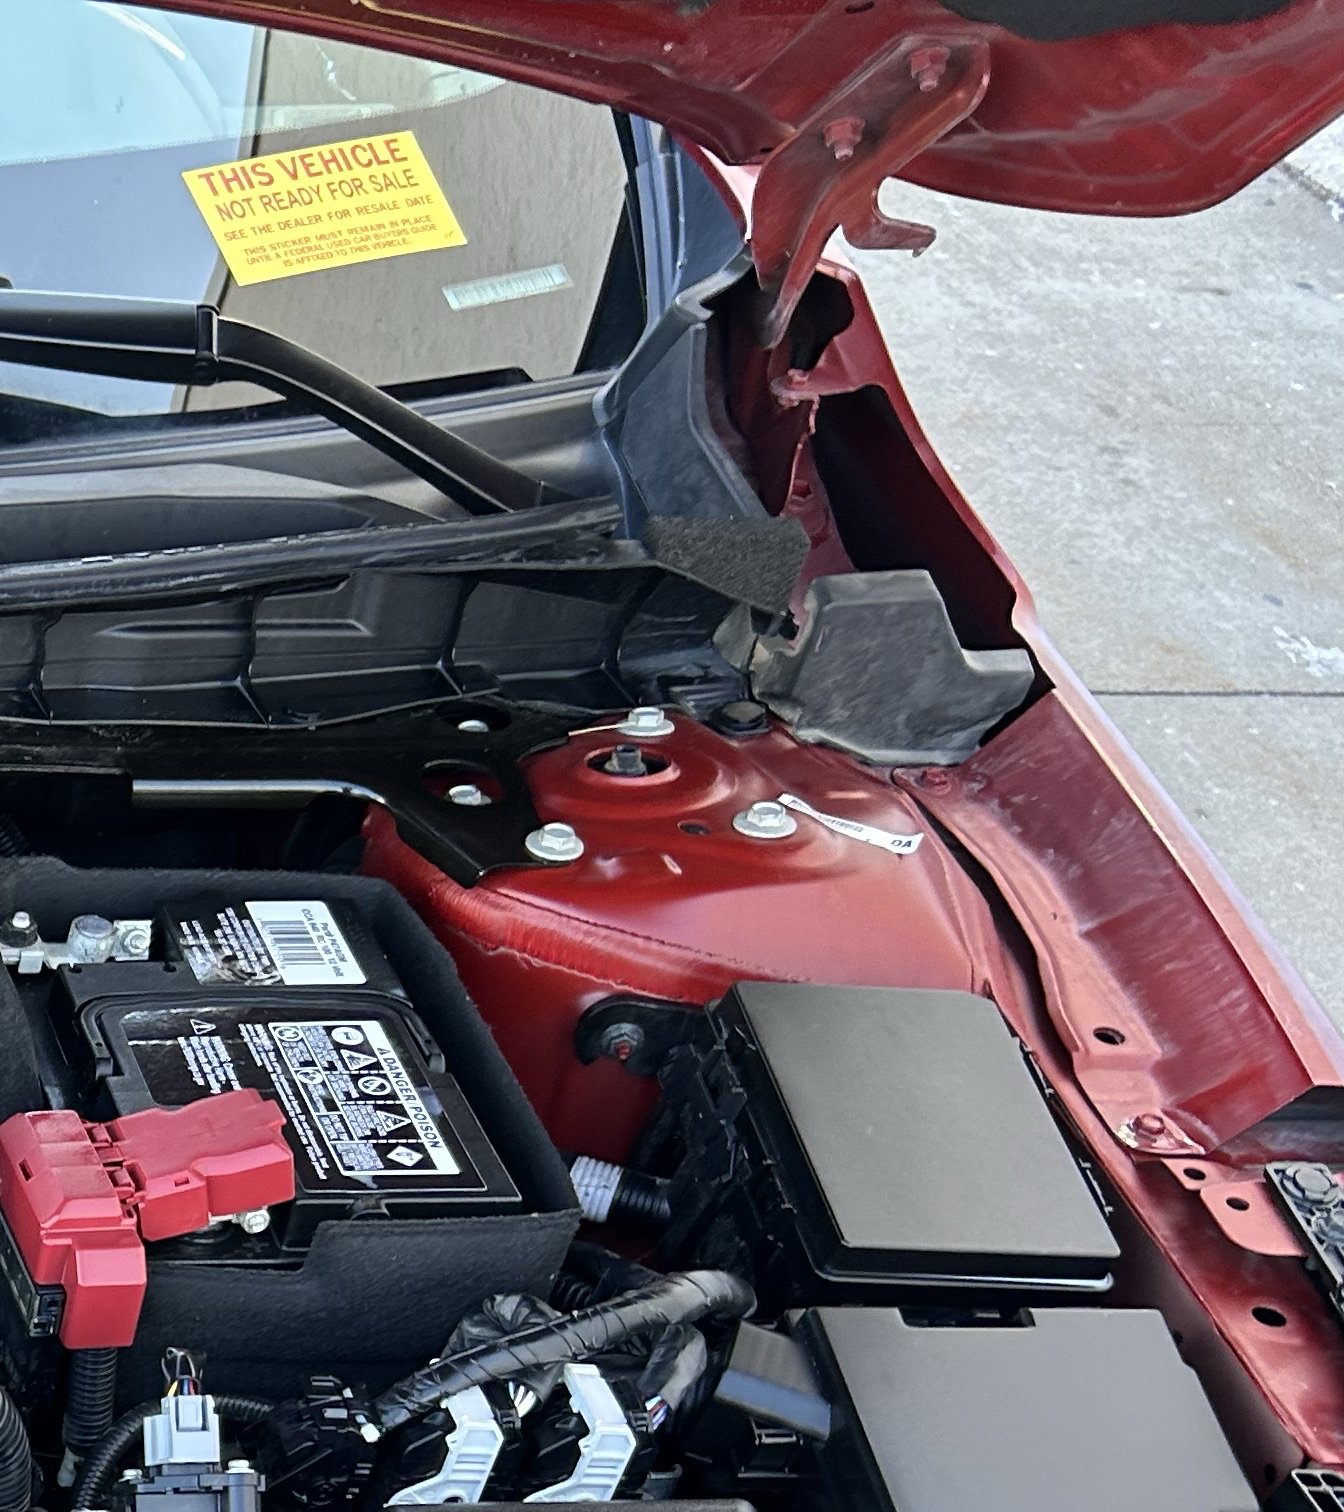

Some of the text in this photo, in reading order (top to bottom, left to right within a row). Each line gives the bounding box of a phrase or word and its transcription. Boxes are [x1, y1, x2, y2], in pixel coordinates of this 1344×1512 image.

[196, 137, 408, 197] THIS VEHICLE
[213, 167, 419, 221] NOT READY FOR SALE
[222, 194, 434, 241] SEE THE DEALER FOR RESALE DATE
[241, 214, 432, 256] THIS STICKER MUST REMAIN IN PLACE
